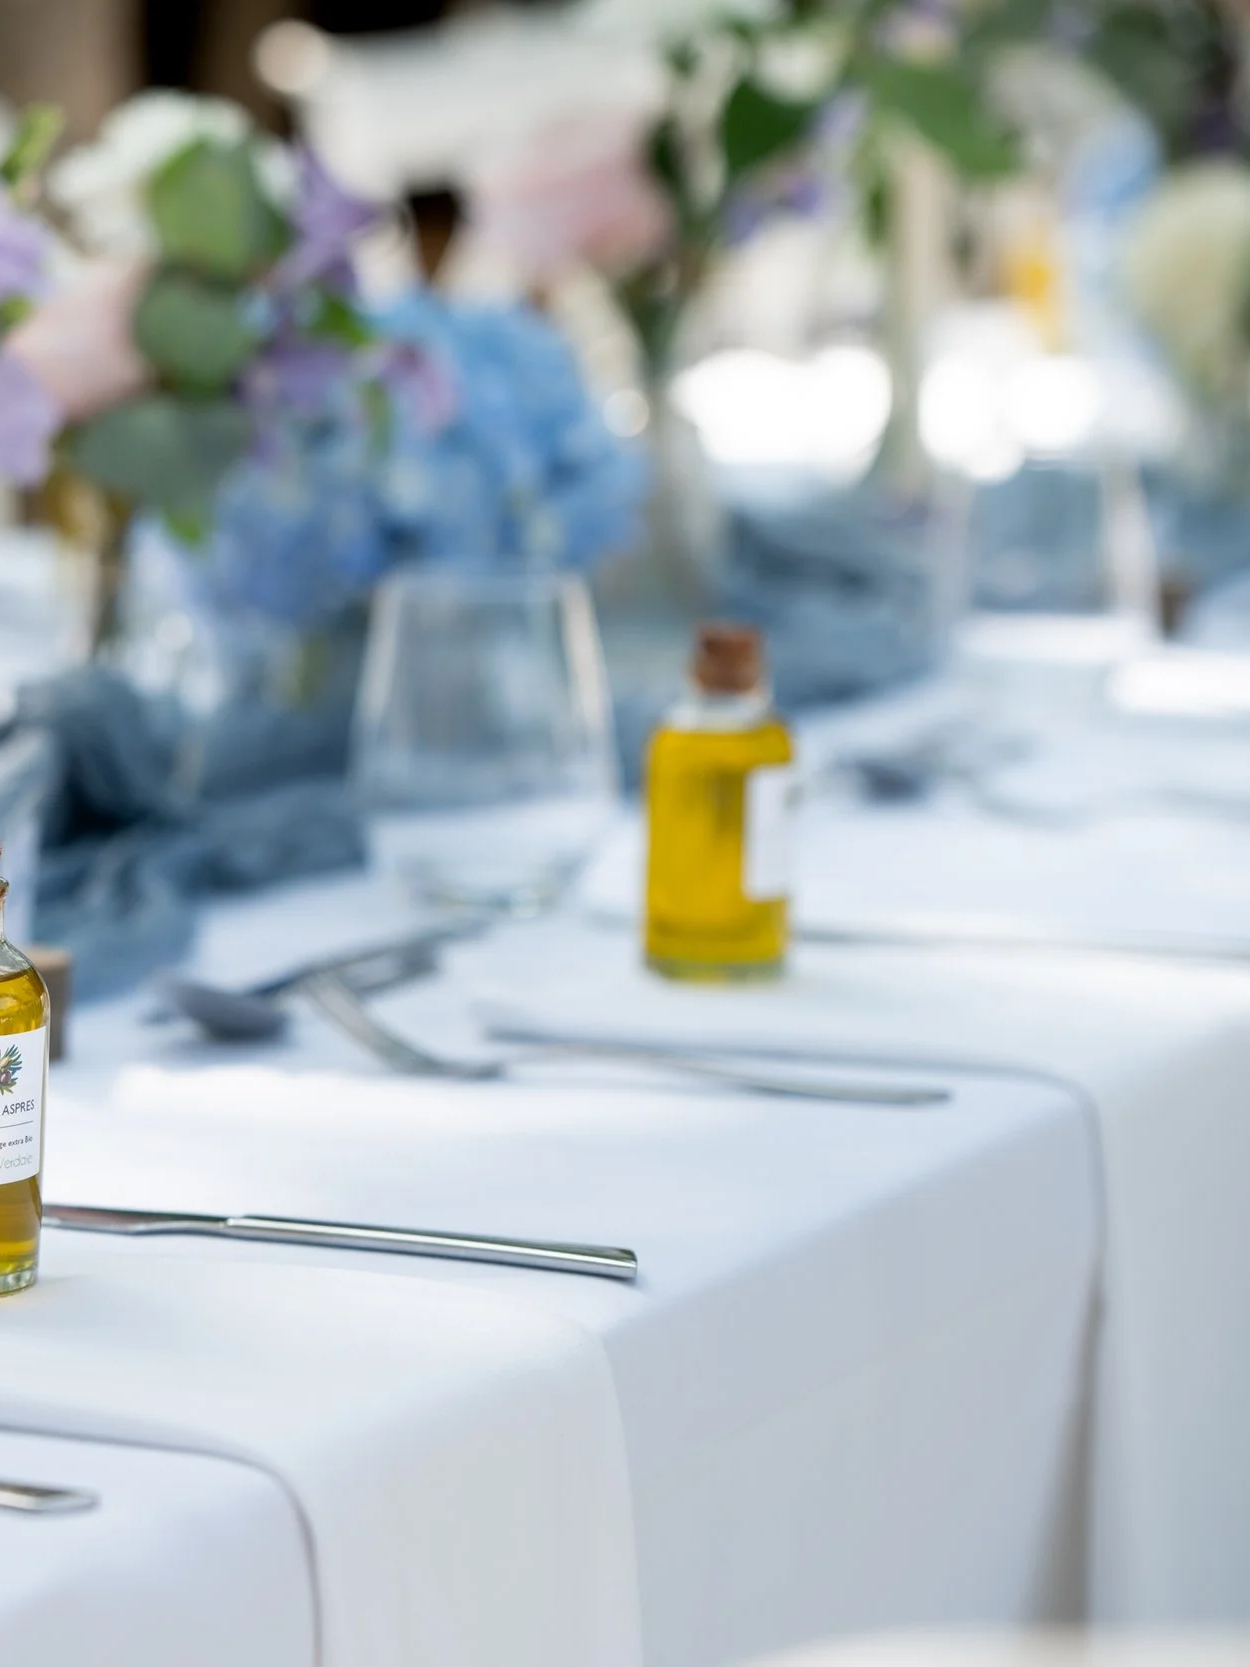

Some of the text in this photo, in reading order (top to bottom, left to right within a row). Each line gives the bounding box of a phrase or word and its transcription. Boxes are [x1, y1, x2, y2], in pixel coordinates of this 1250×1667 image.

[1, 1099, 35, 1116] ASPRES
[7, 1138, 24, 1147] extra
[25, 1135, 33, 1143] Bio
